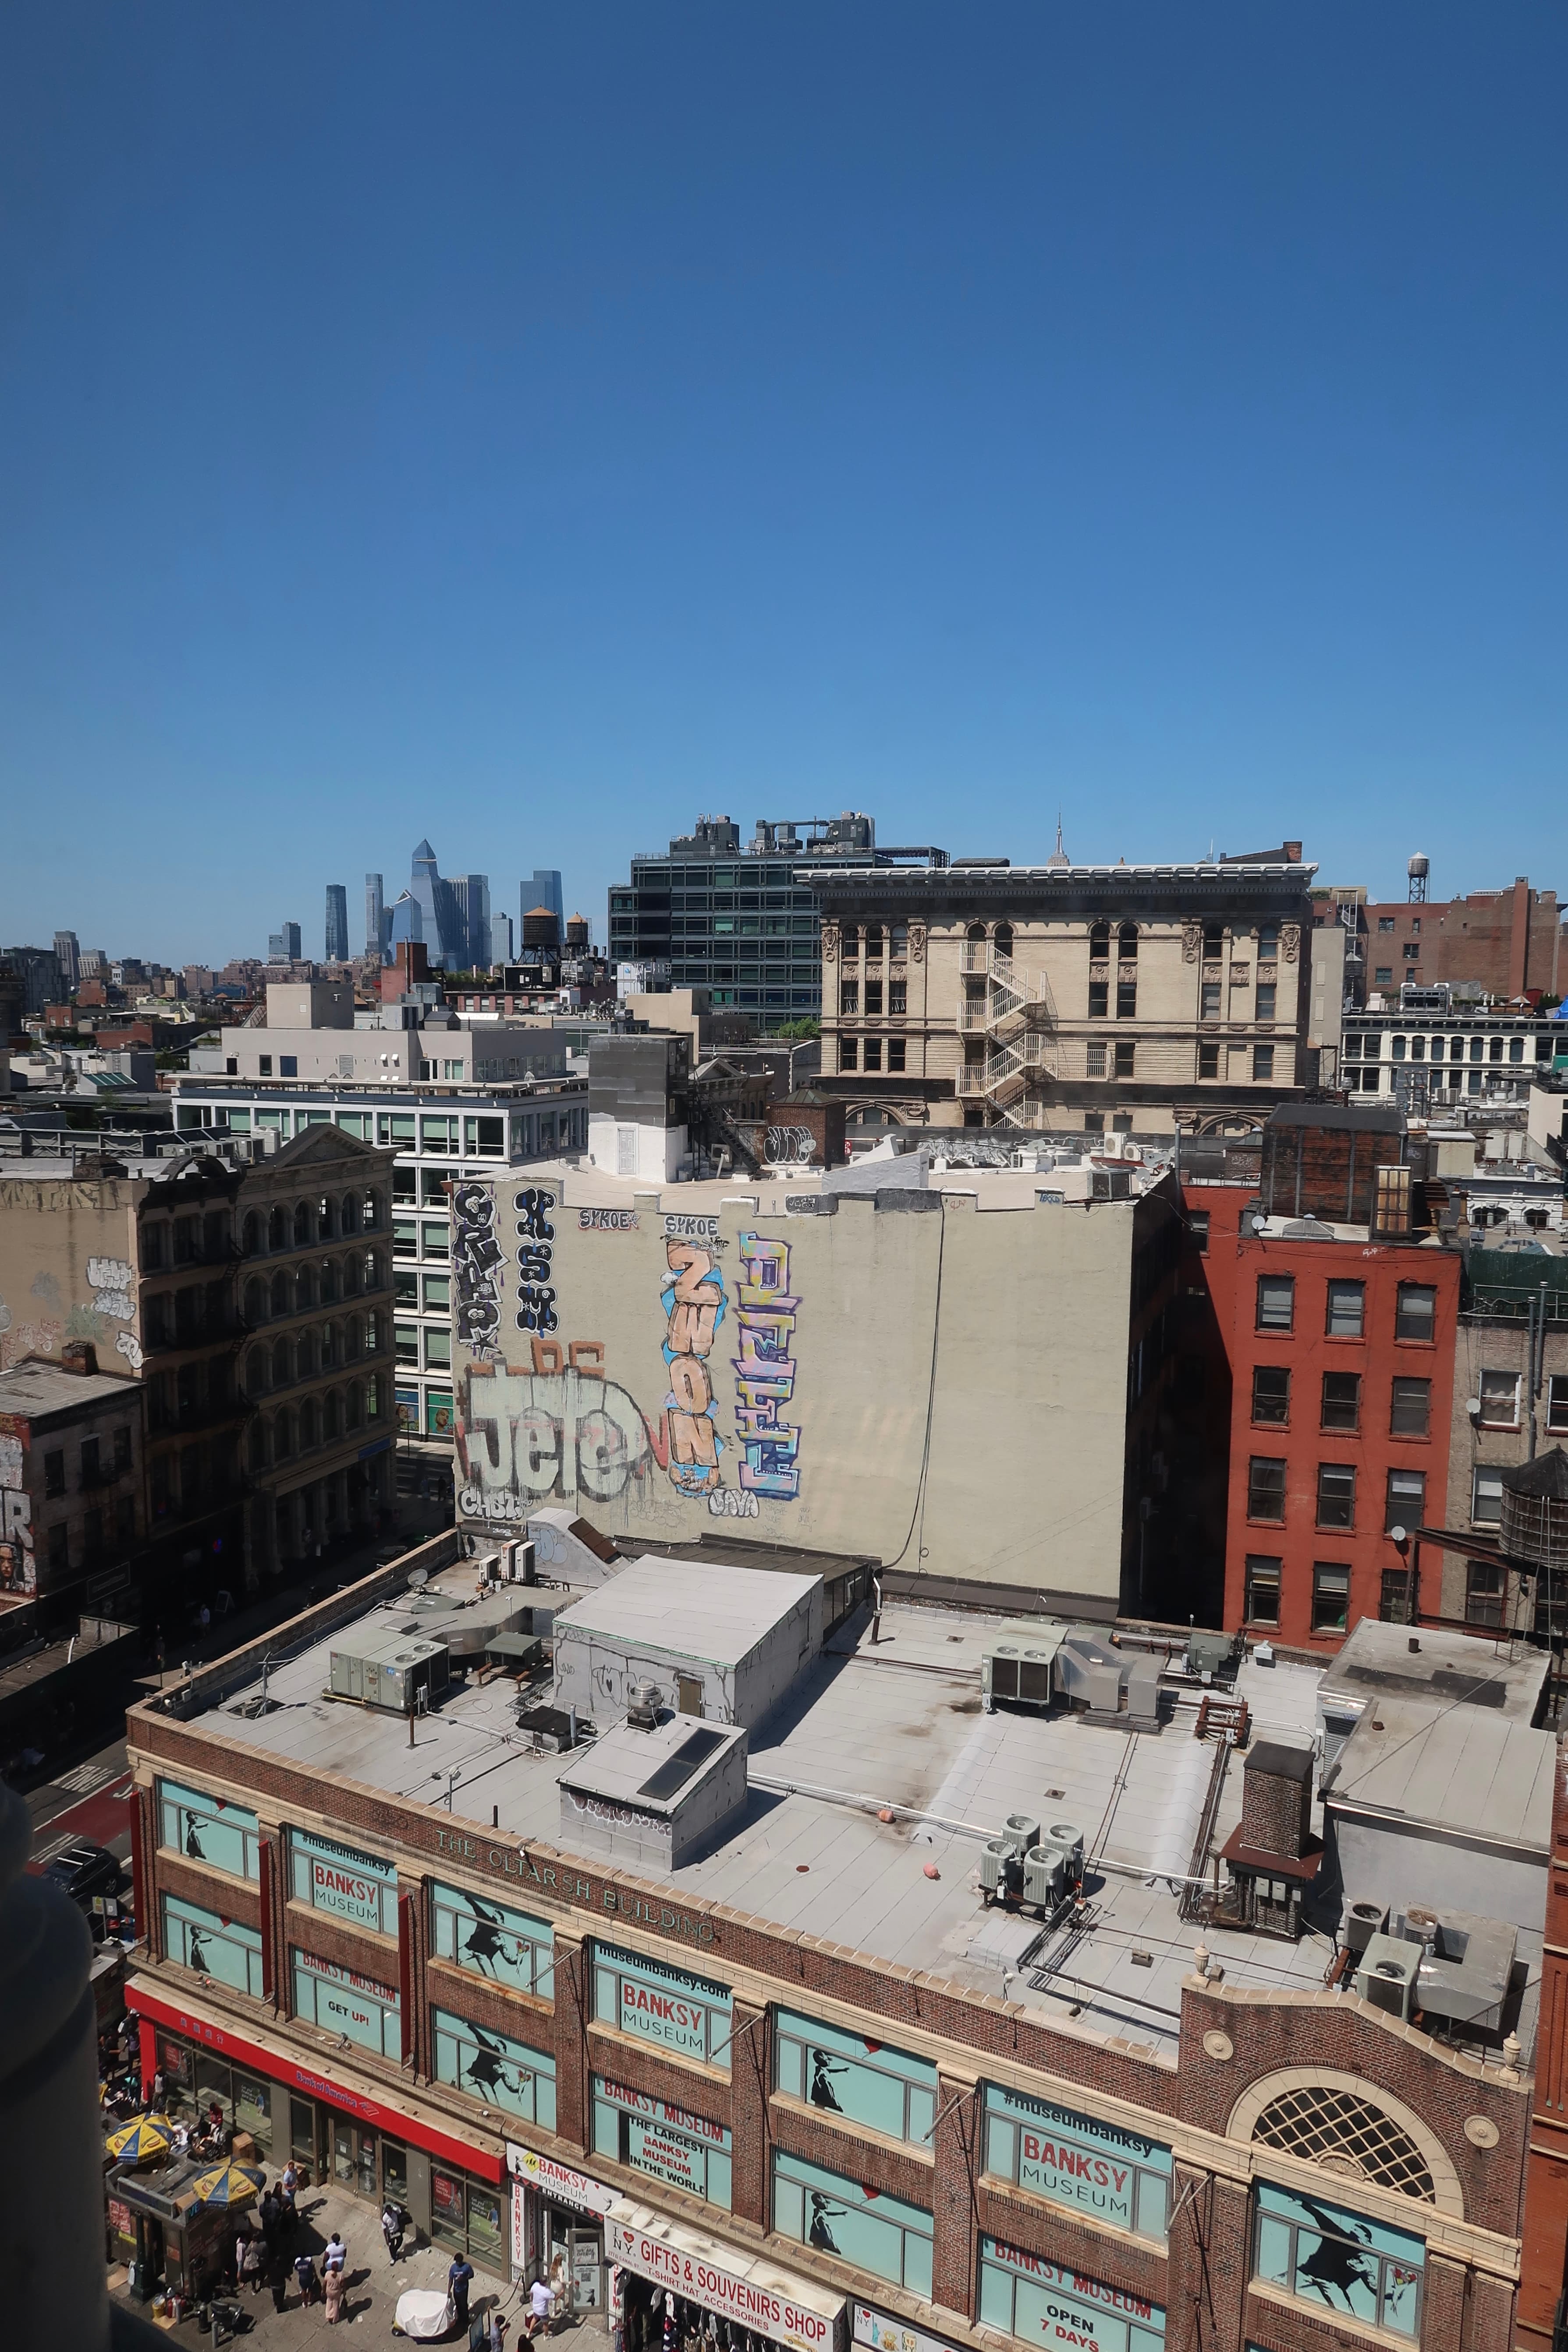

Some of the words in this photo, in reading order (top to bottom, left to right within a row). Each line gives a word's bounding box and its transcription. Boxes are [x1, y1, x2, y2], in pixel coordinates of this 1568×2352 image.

[664, 1215, 718, 1236] SYKOE
[302, 1832, 390, 1876] #museumbanksy
[315, 1865, 376, 1905] BANKSY
[436, 1831, 476, 1859] THE
[604, 1890, 715, 1943] BUILDING
[316, 1889, 378, 1923] MUSEUM
[303, 1951, 345, 1980] BANKSY
[350, 1969, 396, 2003] MUSEUM
[599, 1944, 729, 2000] museumbanksy.com
[328, 2001, 349, 2016] GET
[352, 2010, 370, 2027] UP!
[624, 1983, 702, 2031] BANKSY
[624, 2011, 703, 2052] MUSEUM
[297, 2071, 316, 2089] Bank
[316, 2082, 324, 2093] of
[325, 2084, 357, 2108] America
[604, 2078, 657, 2114] BANKSY
[664, 2104, 723, 2143] MUSEUM
[1004, 2092, 1153, 2157] #museumbanksy
[630, 2117, 651, 2132] THE
[654, 2125, 704, 2154] LARGEST
[644, 2135, 689, 2161] BANKSY
[539, 2158, 588, 2191] BANKSY
[630, 2154, 641, 2167] IN
[642, 2160, 663, 2176] THE
[643, 2148, 691, 2175] MUSEUM
[1024, 2134, 1128, 2192] BANKSY
[539, 2173, 588, 2203] MUSEUM
[542, 2188, 585, 2212] ENTRANCE
[1024, 2165, 1127, 2217] MUSEUM
[641, 2240, 679, 2275] GIFTS
[684, 2259, 693, 2281] &
[698, 2264, 780, 2322] SOUVENIRS
[785, 2306, 826, 2342] SHOP
[648, 2266, 680, 2288] T-SHIRT
[682, 2281, 700, 2298] HAT
[703, 2294, 769, 2331] ACCESSORIES
[995, 2242, 1064, 2283] BANKSY
[1073, 2274, 1152, 2320] MUSEUM
[1040, 2318, 1050, 2331] 7
[1055, 2326, 1099, 2352] DAYS
[1047, 2305, 1094, 2333] OPEN
